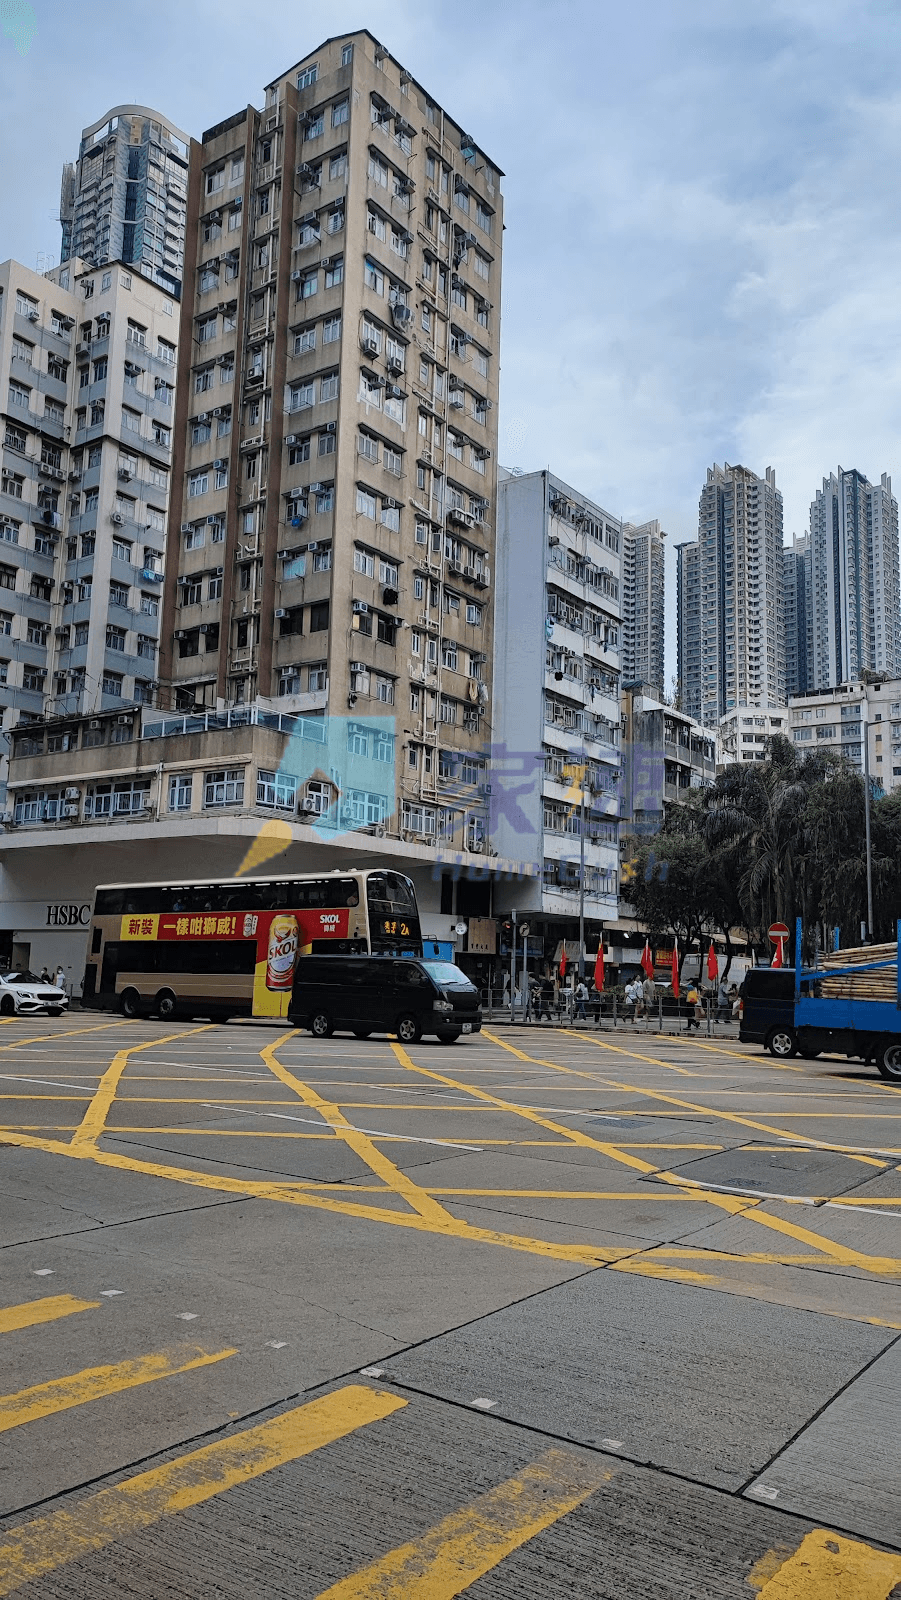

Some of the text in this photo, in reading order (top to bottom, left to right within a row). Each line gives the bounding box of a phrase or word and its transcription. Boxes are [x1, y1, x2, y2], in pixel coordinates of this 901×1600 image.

[46, 904, 91, 925] HSBC
[320, 915, 340, 923] SKOL
[128, 918, 154, 936] 新裝
[401, 923, 409, 935] 2A
[268, 940, 298, 961] SKOL
